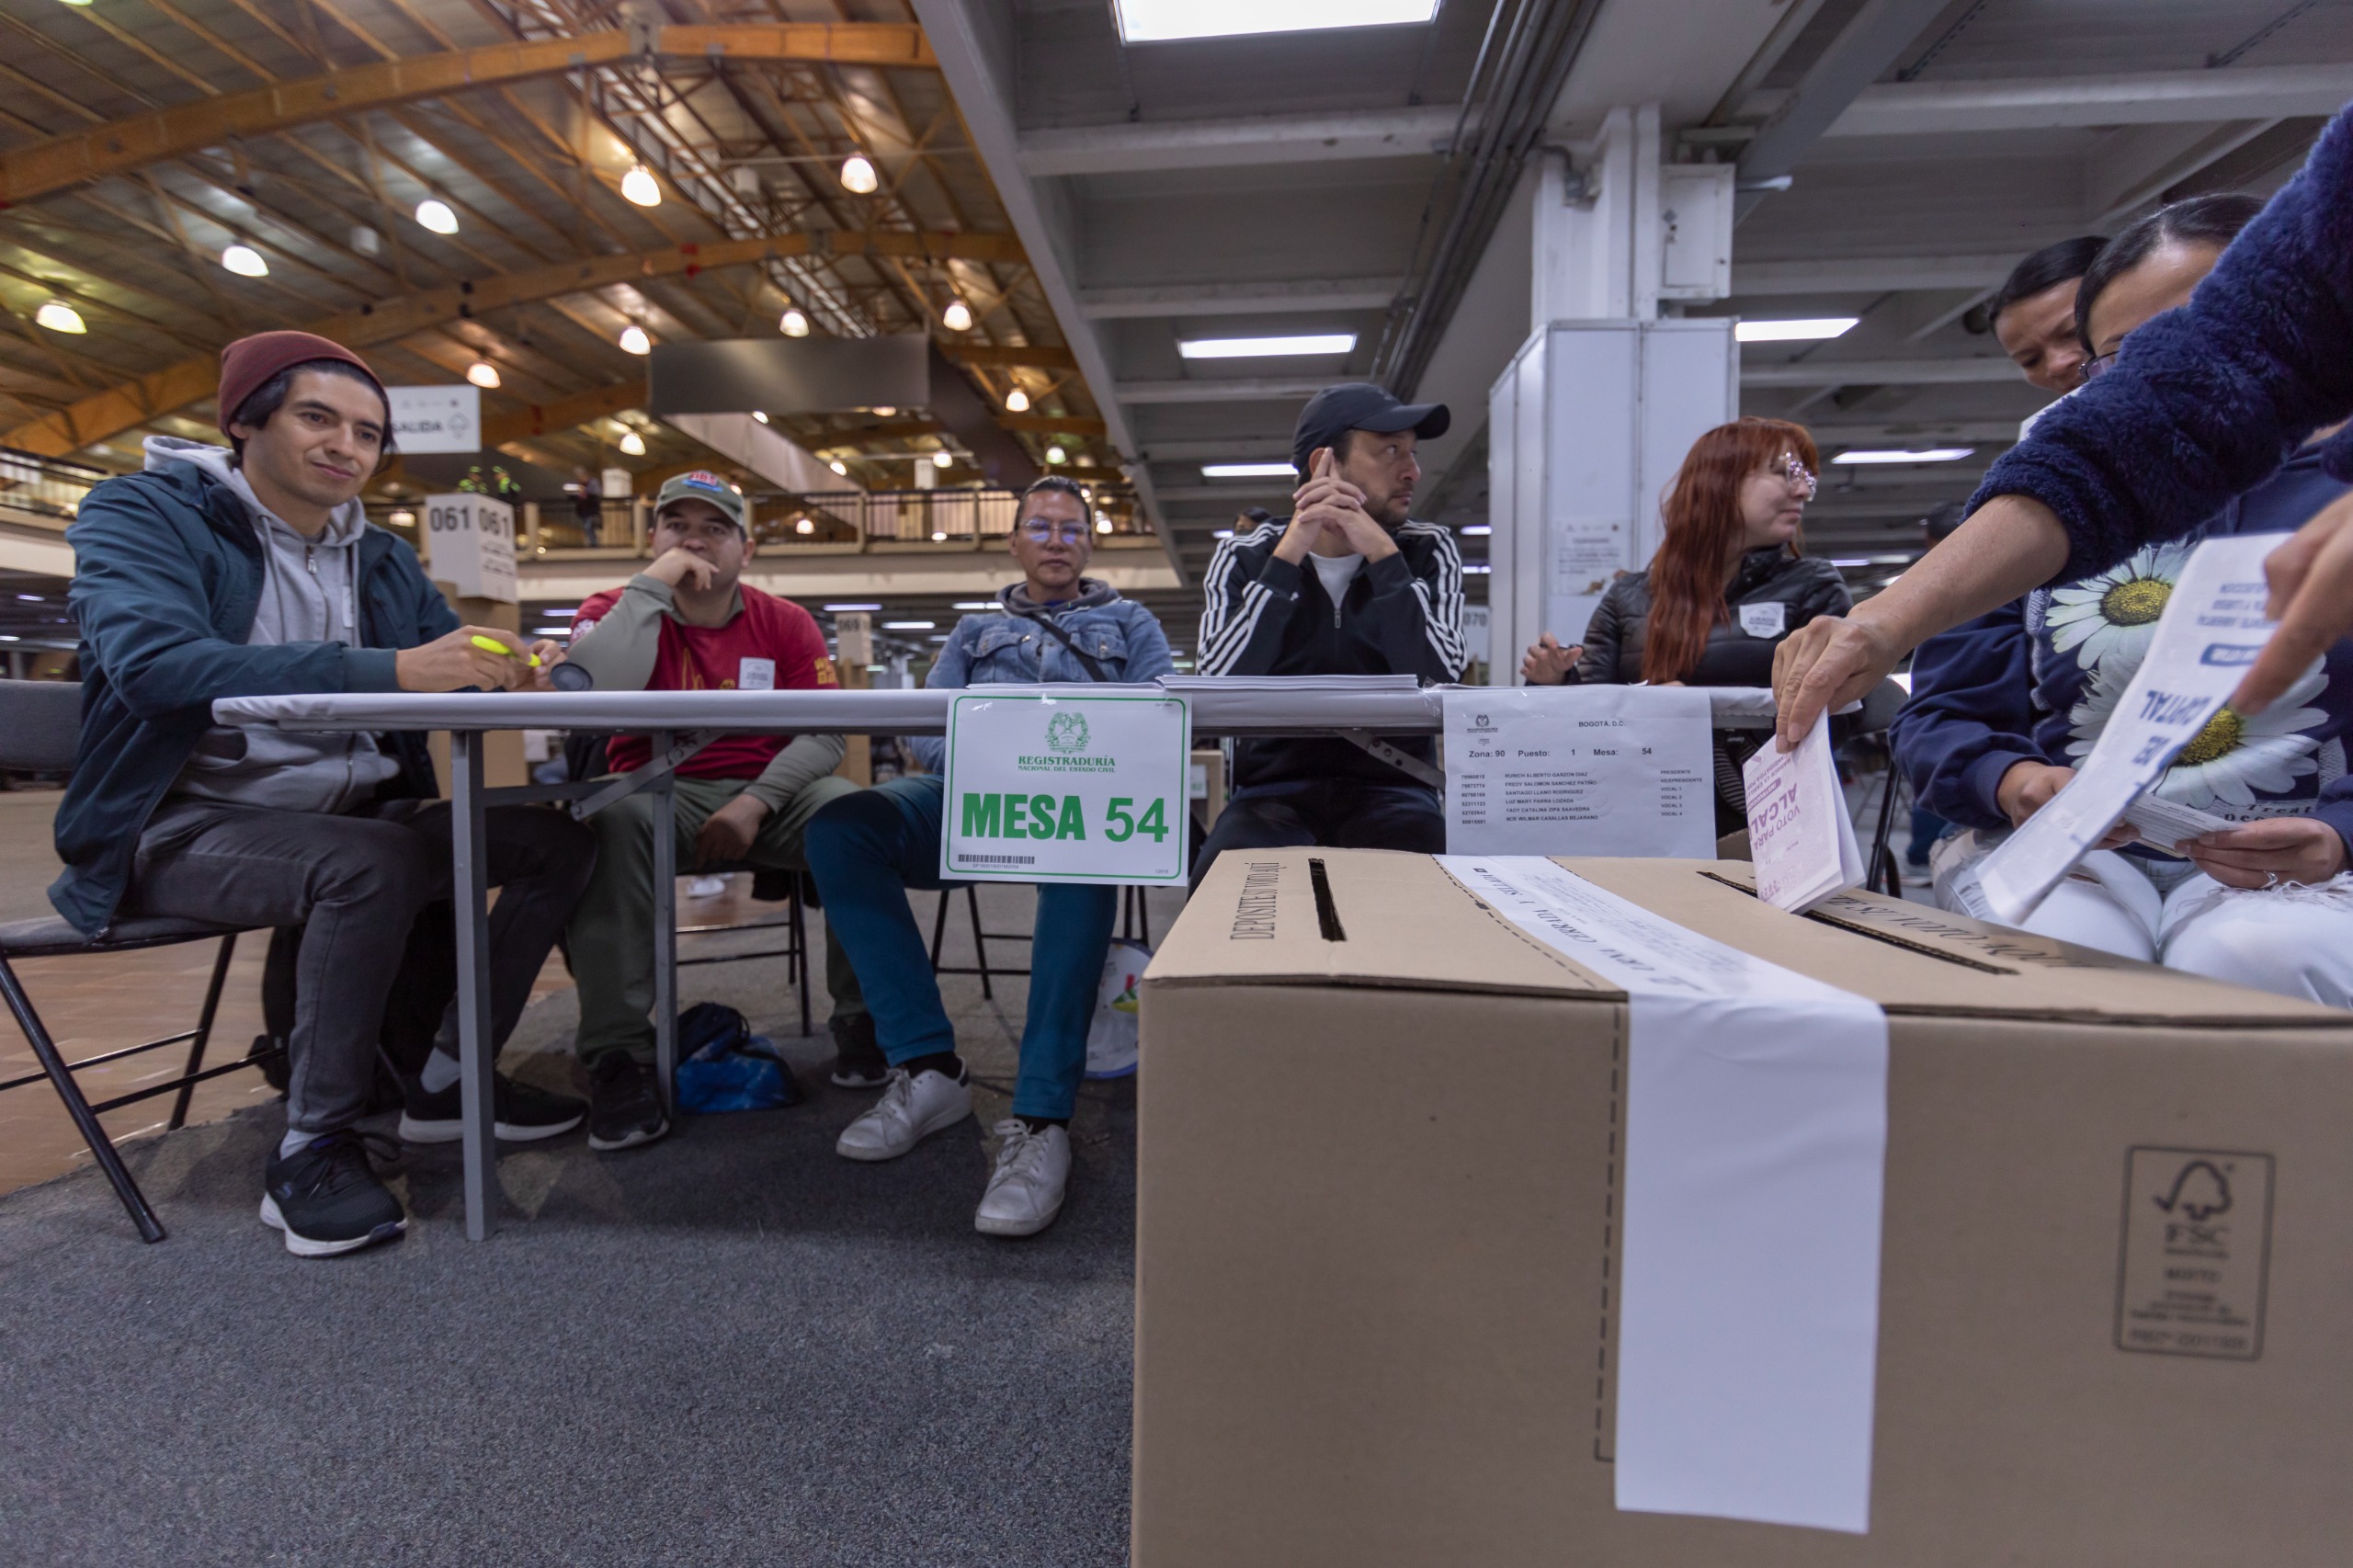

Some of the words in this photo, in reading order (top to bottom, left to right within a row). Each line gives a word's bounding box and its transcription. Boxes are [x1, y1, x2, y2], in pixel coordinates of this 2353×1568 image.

[430, 507, 472, 531] 061
[1017, 755, 1116, 767] REGISTRADURÍA
[1469, 750, 1493, 758] Zona:
[961, 792, 1086, 840] MESA
[1104, 797, 1169, 843] 54
[1776, 804, 1801, 831] VOTO
[2247, 803, 2313, 813] Treat
[1754, 827, 1775, 851] PARA
[1245, 873, 1279, 888] VOTO
[1230, 895, 1277, 940] DEPOSITE
[1532, 908, 1597, 943] CERRADA
